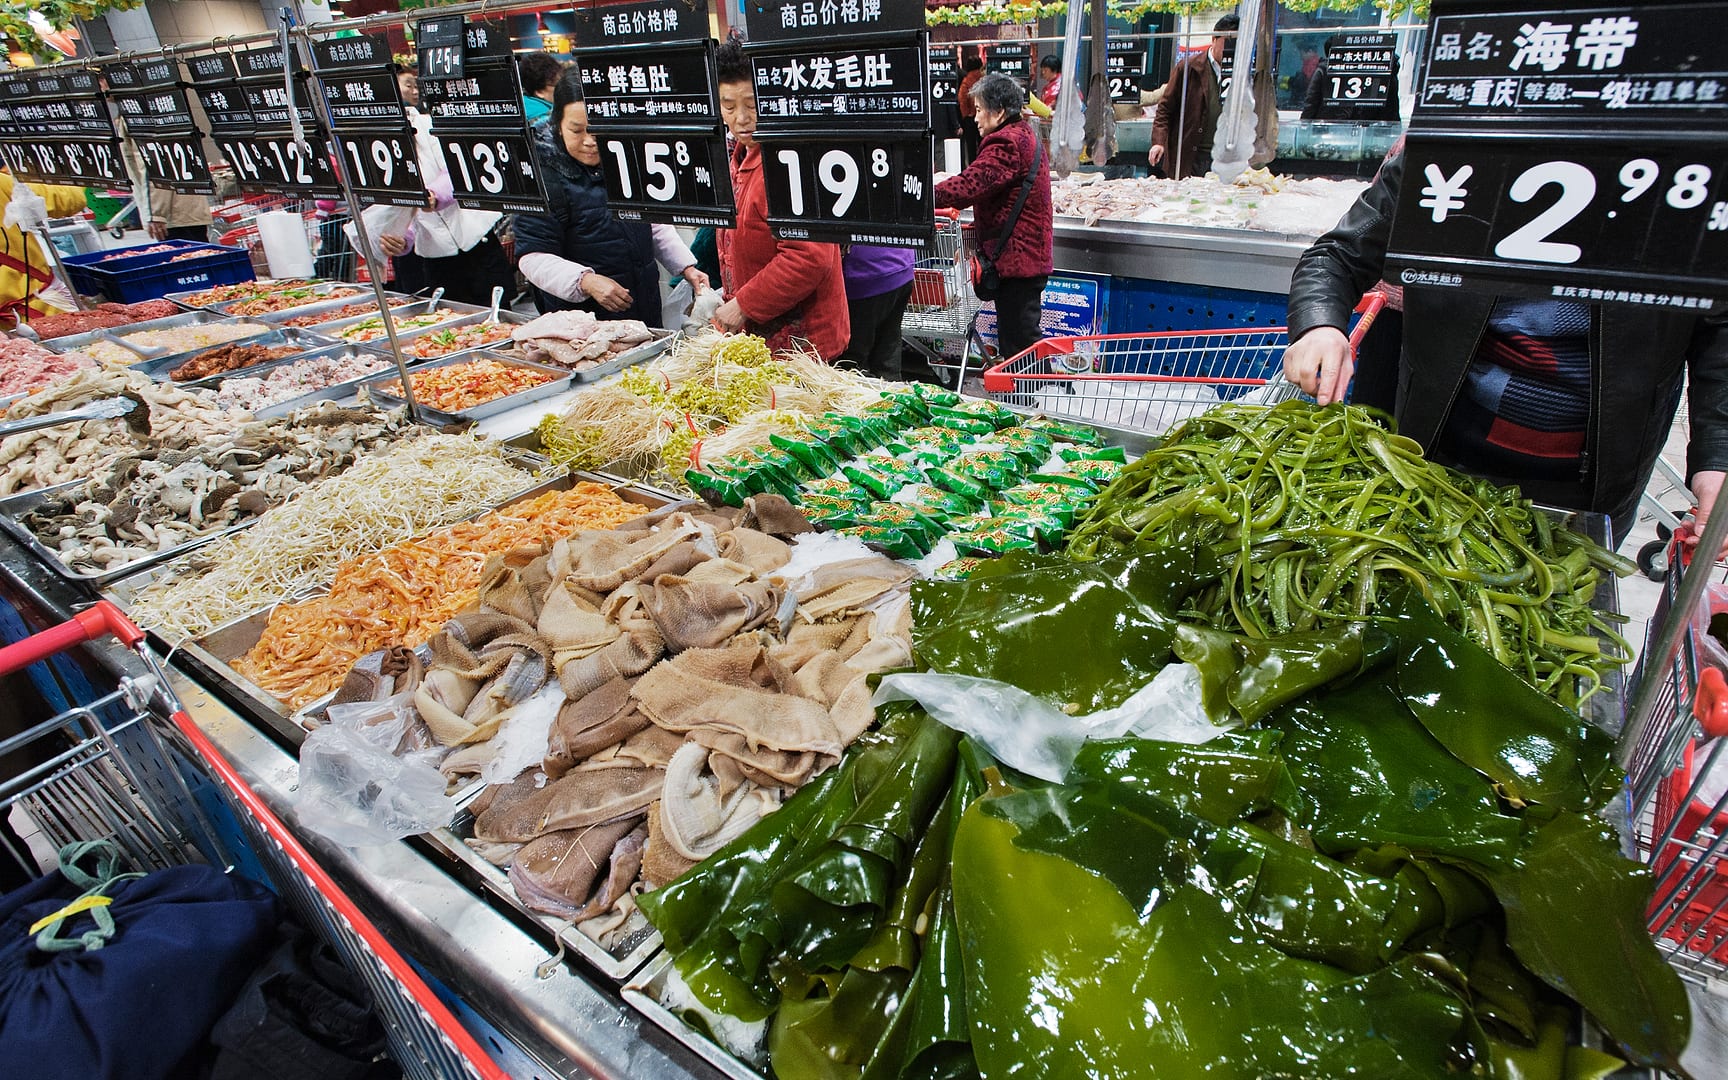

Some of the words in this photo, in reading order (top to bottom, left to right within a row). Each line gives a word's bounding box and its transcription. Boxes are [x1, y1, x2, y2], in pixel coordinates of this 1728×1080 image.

[602, 8, 679, 37] 商品价格牌
[780, 0, 882, 29] 商品价格牌
[328, 42, 374, 63] 商品价格牌
[1434, 31, 1502, 61] 品名:
[1508, 16, 1639, 72] 海带
[581, 69, 605, 84] 品名:
[607, 64, 671, 94] 鲜鱼肚
[783, 53, 893, 91] 水发毛肚
[445, 78, 481, 98] 鲜鸭肠
[1331, 77, 1373, 99] 13.8
[687, 103, 709, 115] 500g
[892, 97, 918, 111] 500g
[346, 139, 403, 187] 19.8
[449, 141, 509, 193] 13.8
[607, 140, 690, 201] 15.8
[695, 166, 711, 188] 500g
[777, 148, 890, 218] 19.8
[903, 174, 923, 201] 500g
[1419, 163, 1474, 223] ¥
[1494, 158, 1713, 264] 2.98
